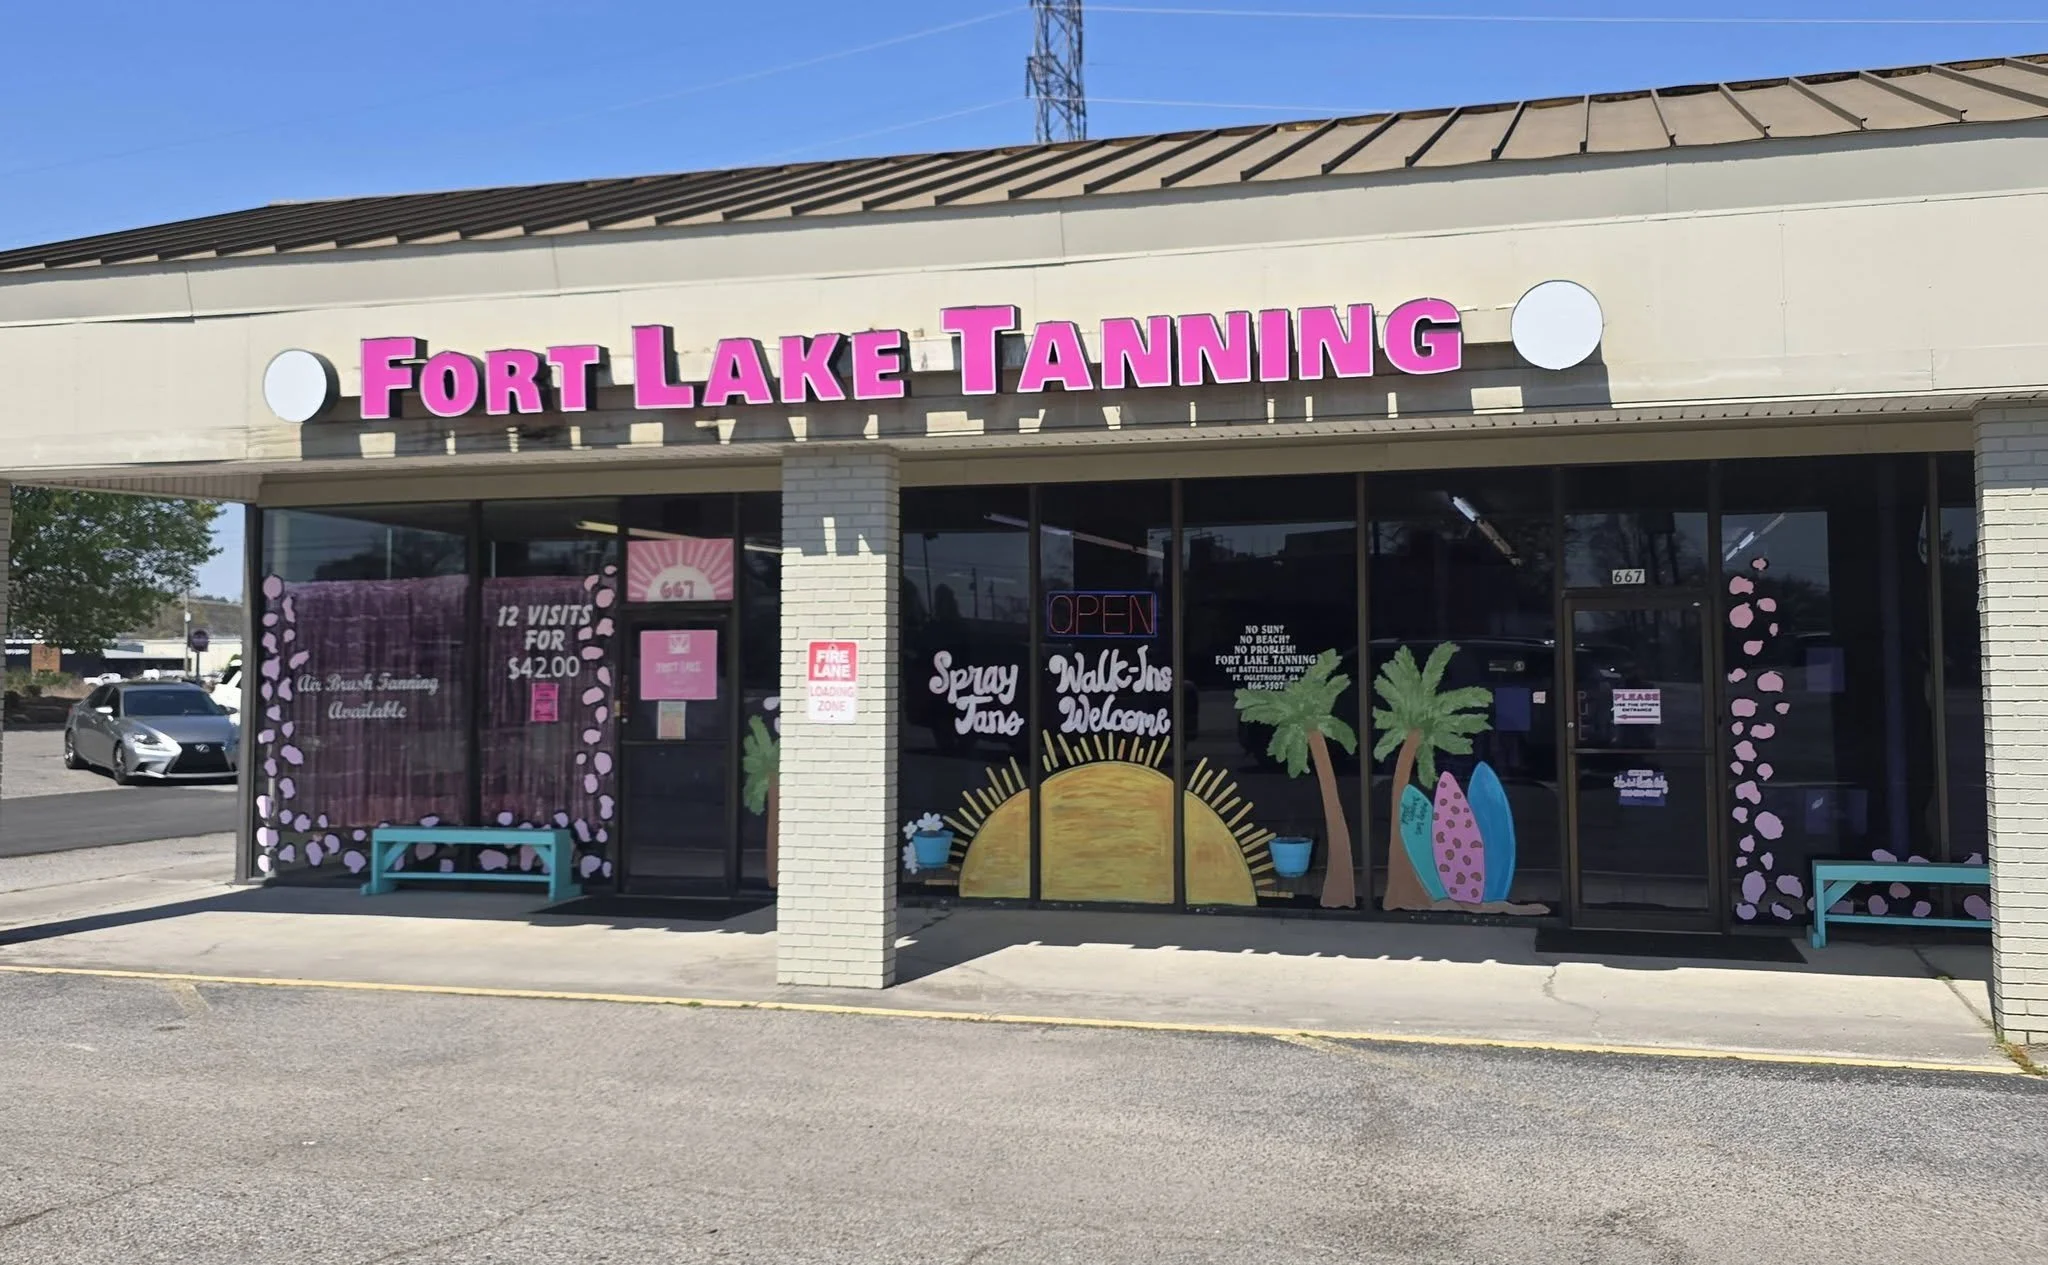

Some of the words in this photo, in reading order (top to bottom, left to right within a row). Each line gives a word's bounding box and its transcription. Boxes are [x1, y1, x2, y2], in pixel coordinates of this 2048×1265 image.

[360, 336, 601, 420] FORT
[632, 325, 905, 410] LAKE
[940, 297, 1462, 396] TANNING
[1614, 570, 1643, 583] 667
[660, 580, 695, 600] 667
[497, 605, 520, 627] 12
[527, 604, 594, 626] VISITS
[1049, 595, 1155, 635] OPEN
[1245, 625, 1259, 634] NO
[1261, 624, 1285, 634] SUN?
[524, 629, 566, 651] FOR
[1234, 645, 1248, 655] NO
[1250, 644, 1297, 654] PROBLEM!
[1239, 635, 1253, 645] NO
[1255, 635, 1291, 644] BEACH?
[815, 649, 850, 664] FIRE
[1215, 655, 1241, 665] FORT
[1244, 655, 1269, 665] LAKE
[1272, 654, 1316, 665] TANNING
[508, 655, 580, 680] $42.00
[813, 663, 852, 679] LANE
[929, 650, 1019, 704] Spray
[1049, 644, 1173, 693] Walk-Ins
[297, 673, 322, 692] Air
[326, 673, 374, 692] Brush
[376, 672, 440, 696] Tanning
[810, 686, 855, 698] LOADING
[817, 700, 848, 712] ZONE
[1614, 693, 1660, 701] PLEASE
[328, 701, 408, 719] Available
[954, 694, 1025, 736] Tans
[1058, 694, 1172, 737] Welcome
